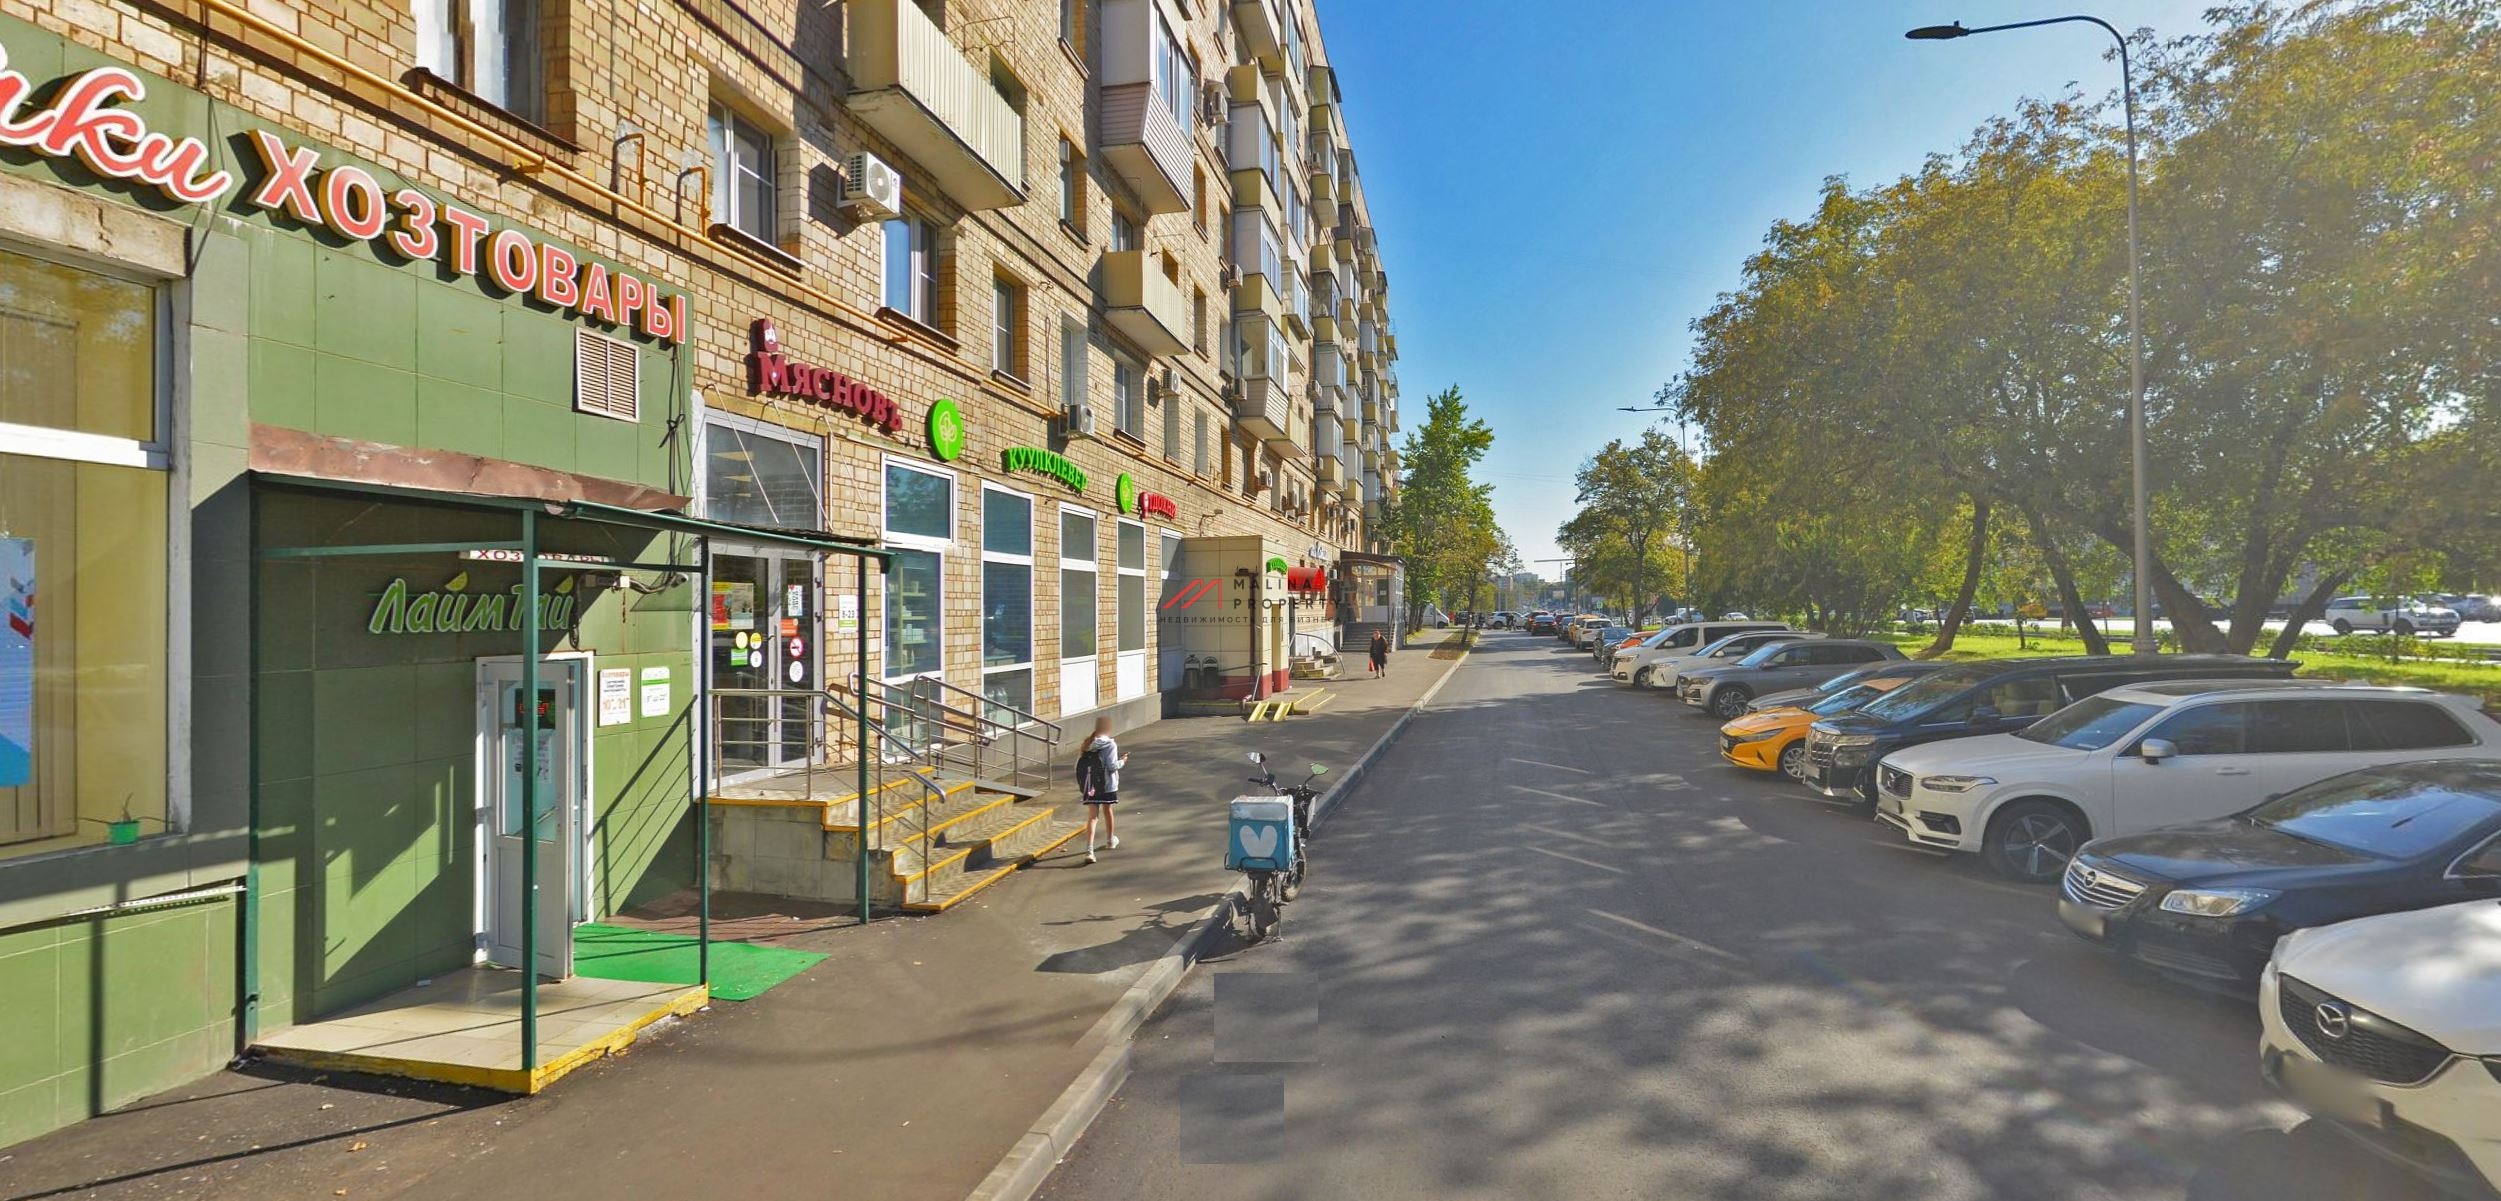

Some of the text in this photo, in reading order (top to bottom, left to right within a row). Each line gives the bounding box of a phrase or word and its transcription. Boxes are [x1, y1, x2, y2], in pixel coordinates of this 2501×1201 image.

[249, 128, 686, 345] ХОЗТОВАРЫ
[1009, 447, 1088, 492] КУУЛКЛЕВЕР
[478, 550, 606, 563] ХОЗОВАРЫ
